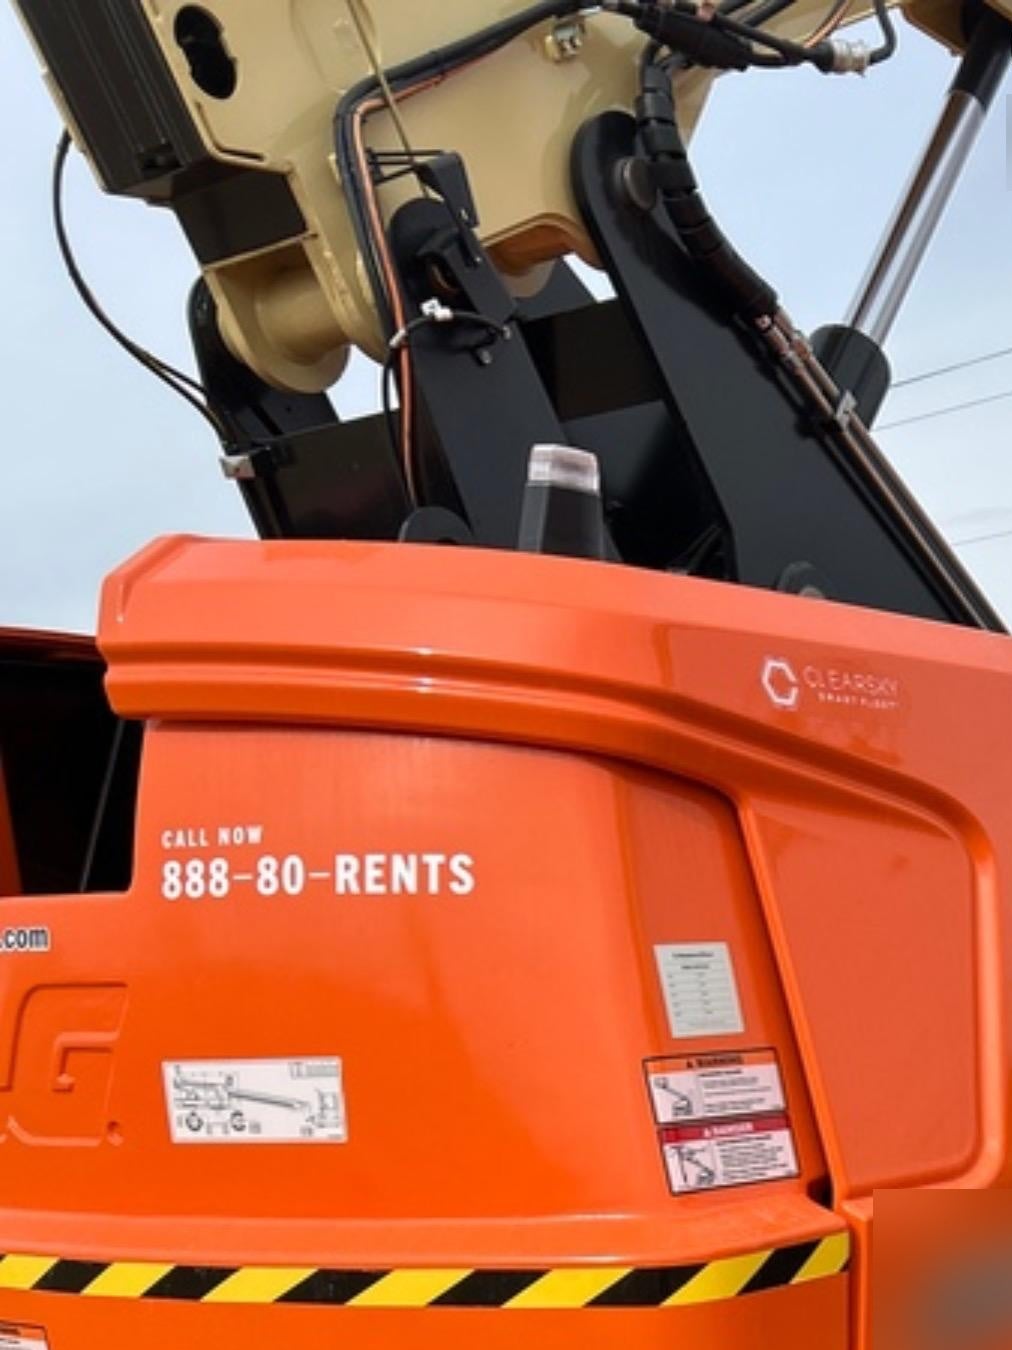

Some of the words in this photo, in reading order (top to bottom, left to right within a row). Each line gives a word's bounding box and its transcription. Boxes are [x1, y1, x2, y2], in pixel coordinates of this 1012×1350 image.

[161, 829, 209, 850] CALL
[218, 825, 263, 847] NOW
[162, 854, 475, 899] 888-80-RENTS
